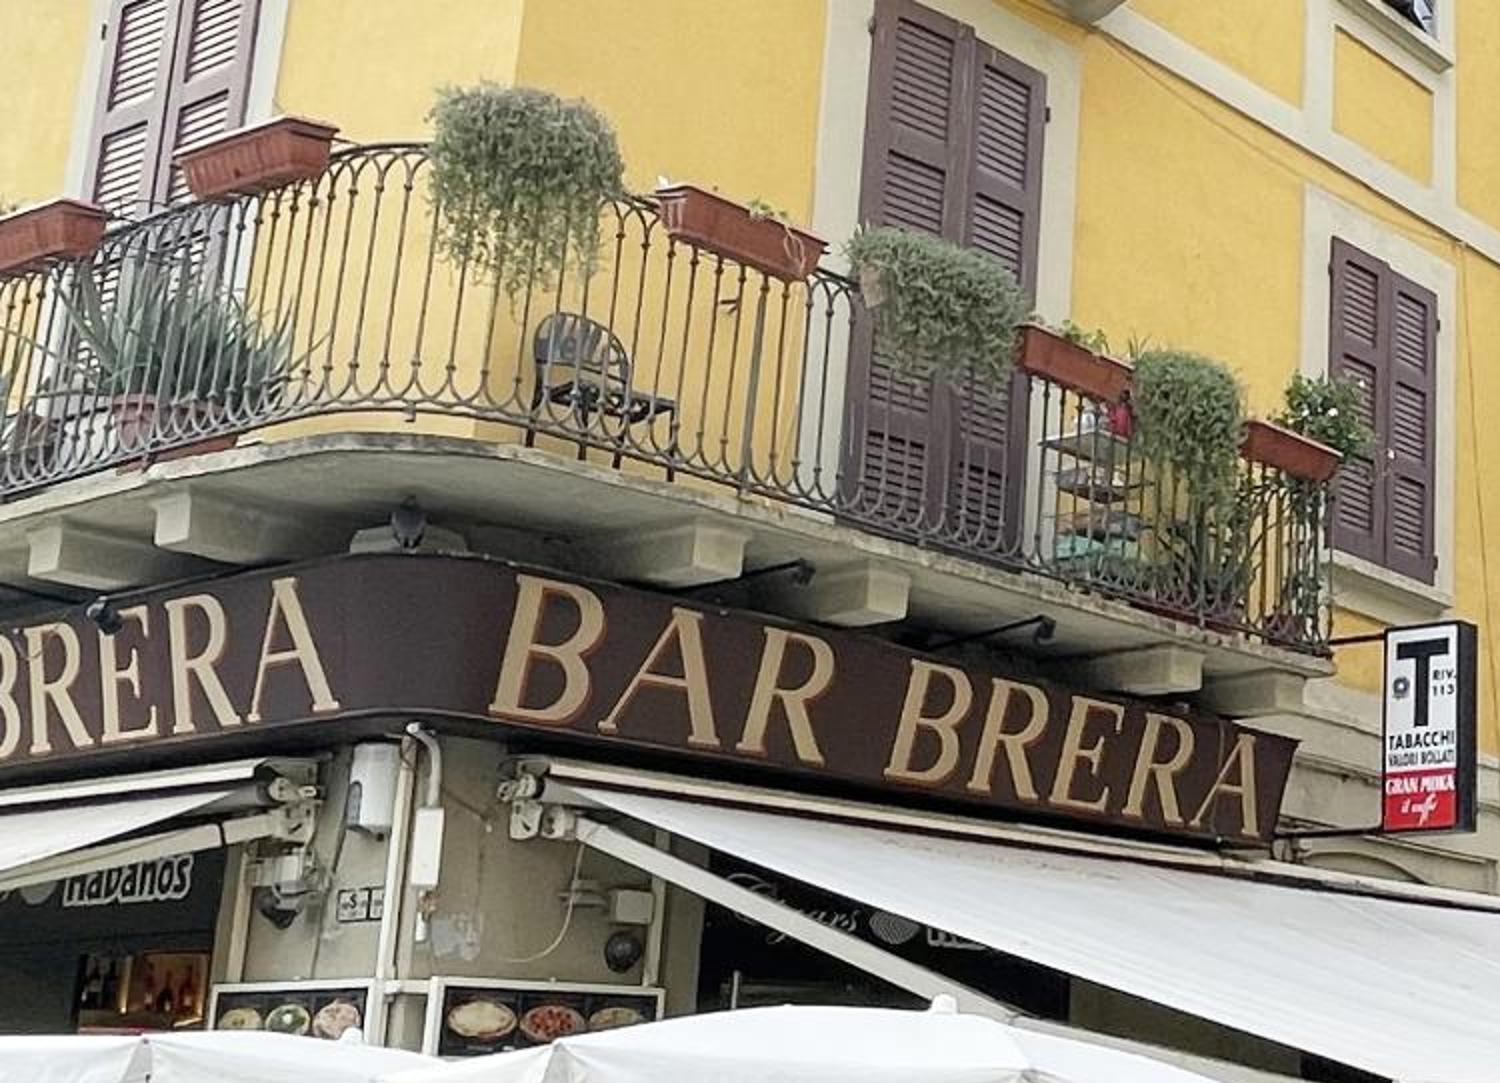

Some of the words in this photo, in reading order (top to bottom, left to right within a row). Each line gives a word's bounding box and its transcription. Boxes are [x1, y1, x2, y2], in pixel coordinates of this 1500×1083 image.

[488, 573, 836, 768] BAR
[883, 657, 1262, 838] BRERA
[1396, 637, 1449, 728] T
[1388, 730, 1455, 751] TABACCHI
